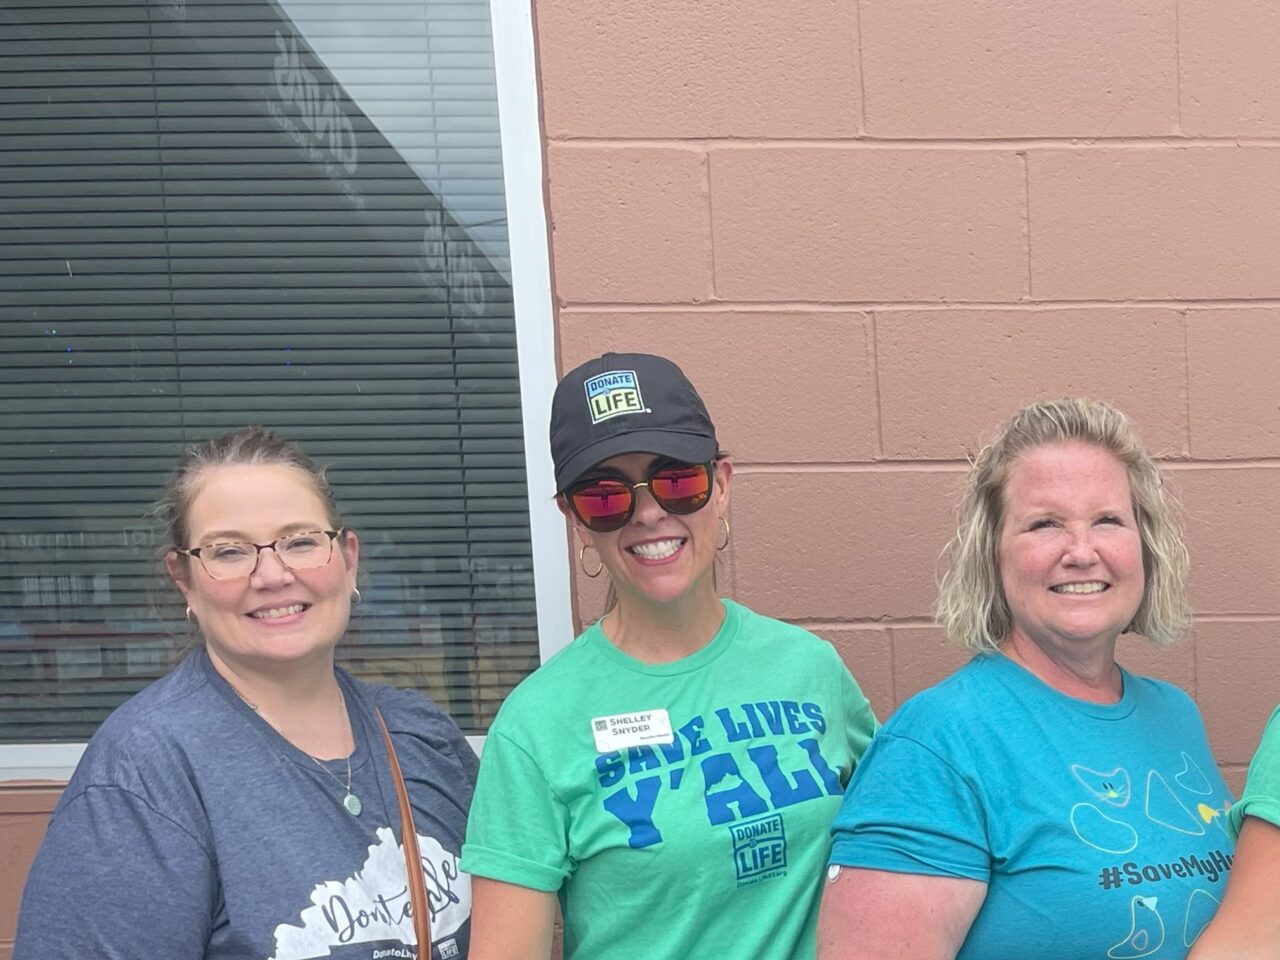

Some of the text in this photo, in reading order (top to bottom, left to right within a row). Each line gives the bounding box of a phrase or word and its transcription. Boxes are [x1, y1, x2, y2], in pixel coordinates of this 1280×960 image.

[590, 374, 633, 391] DONATE
[594, 391, 637, 415] LIFE
[609, 714, 652, 726] SHELLEY
[612, 724, 651, 736] SNYDER
[714, 700, 826, 743] LIVES
[735, 819, 781, 842] DONATE
[738, 841, 783, 874] LIFE
